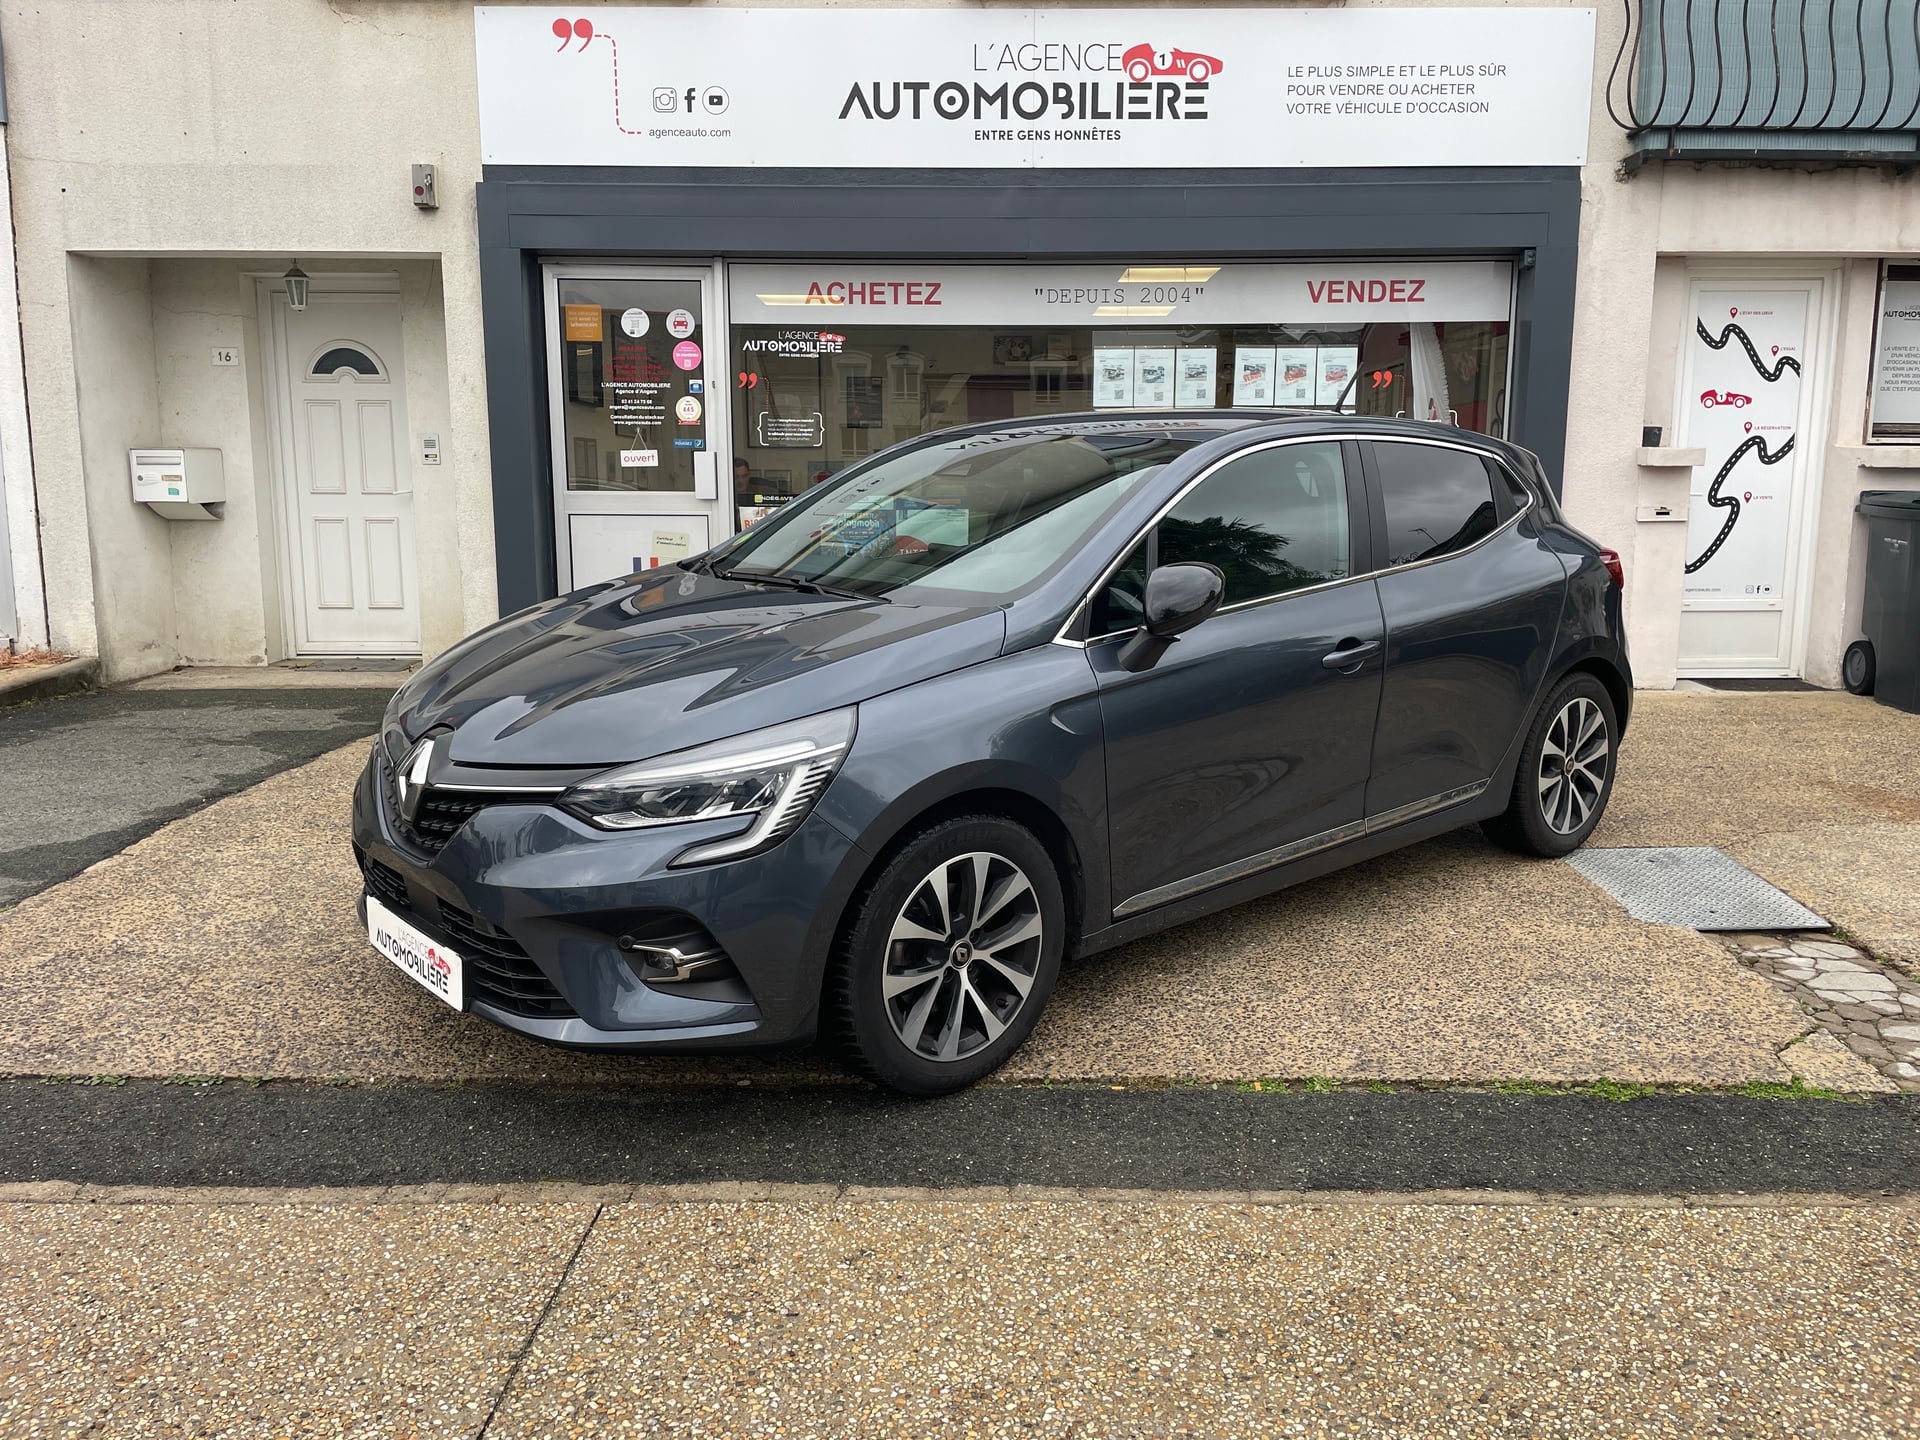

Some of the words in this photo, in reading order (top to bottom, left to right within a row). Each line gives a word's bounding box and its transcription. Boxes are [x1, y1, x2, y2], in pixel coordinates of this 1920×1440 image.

[974, 43, 1123, 72] L'AGENCE
[1158, 53, 1167, 67] 1
[1287, 66, 1304, 77] LE
[1308, 65, 1342, 77] PLUS
[1346, 65, 1395, 77] SIMPLE
[1399, 65, 1416, 76] ET
[1420, 65, 1436, 76] LE
[1440, 65, 1474, 76] PLUS
[1478, 62, 1506, 76] SÛR
[1287, 84, 1325, 96] POUR
[1329, 84, 1384, 96] VENDRE
[1388, 84, 1408, 95] OU
[1411, 83, 1475, 95] ACHETER
[1286, 103, 1332, 114] VOTRE
[1336, 100, 1402, 114] VÉHICULE
[1406, 102, 1489, 113] D'OCCASION
[648, 127, 731, 139] agenceauto.com
[974, 129, 1014, 141] ENTRE
[1016, 129, 1051, 141] GENS
[1054, 126, 1121, 141] HONNÊTES
[805, 281, 942, 305] ACHETEZ
[1306, 279, 1426, 304] VENDEZ
[778, 331, 819, 340] L'AGENCE
[218, 352, 231, 361] 16
[623, 454, 655, 462] ouvert
